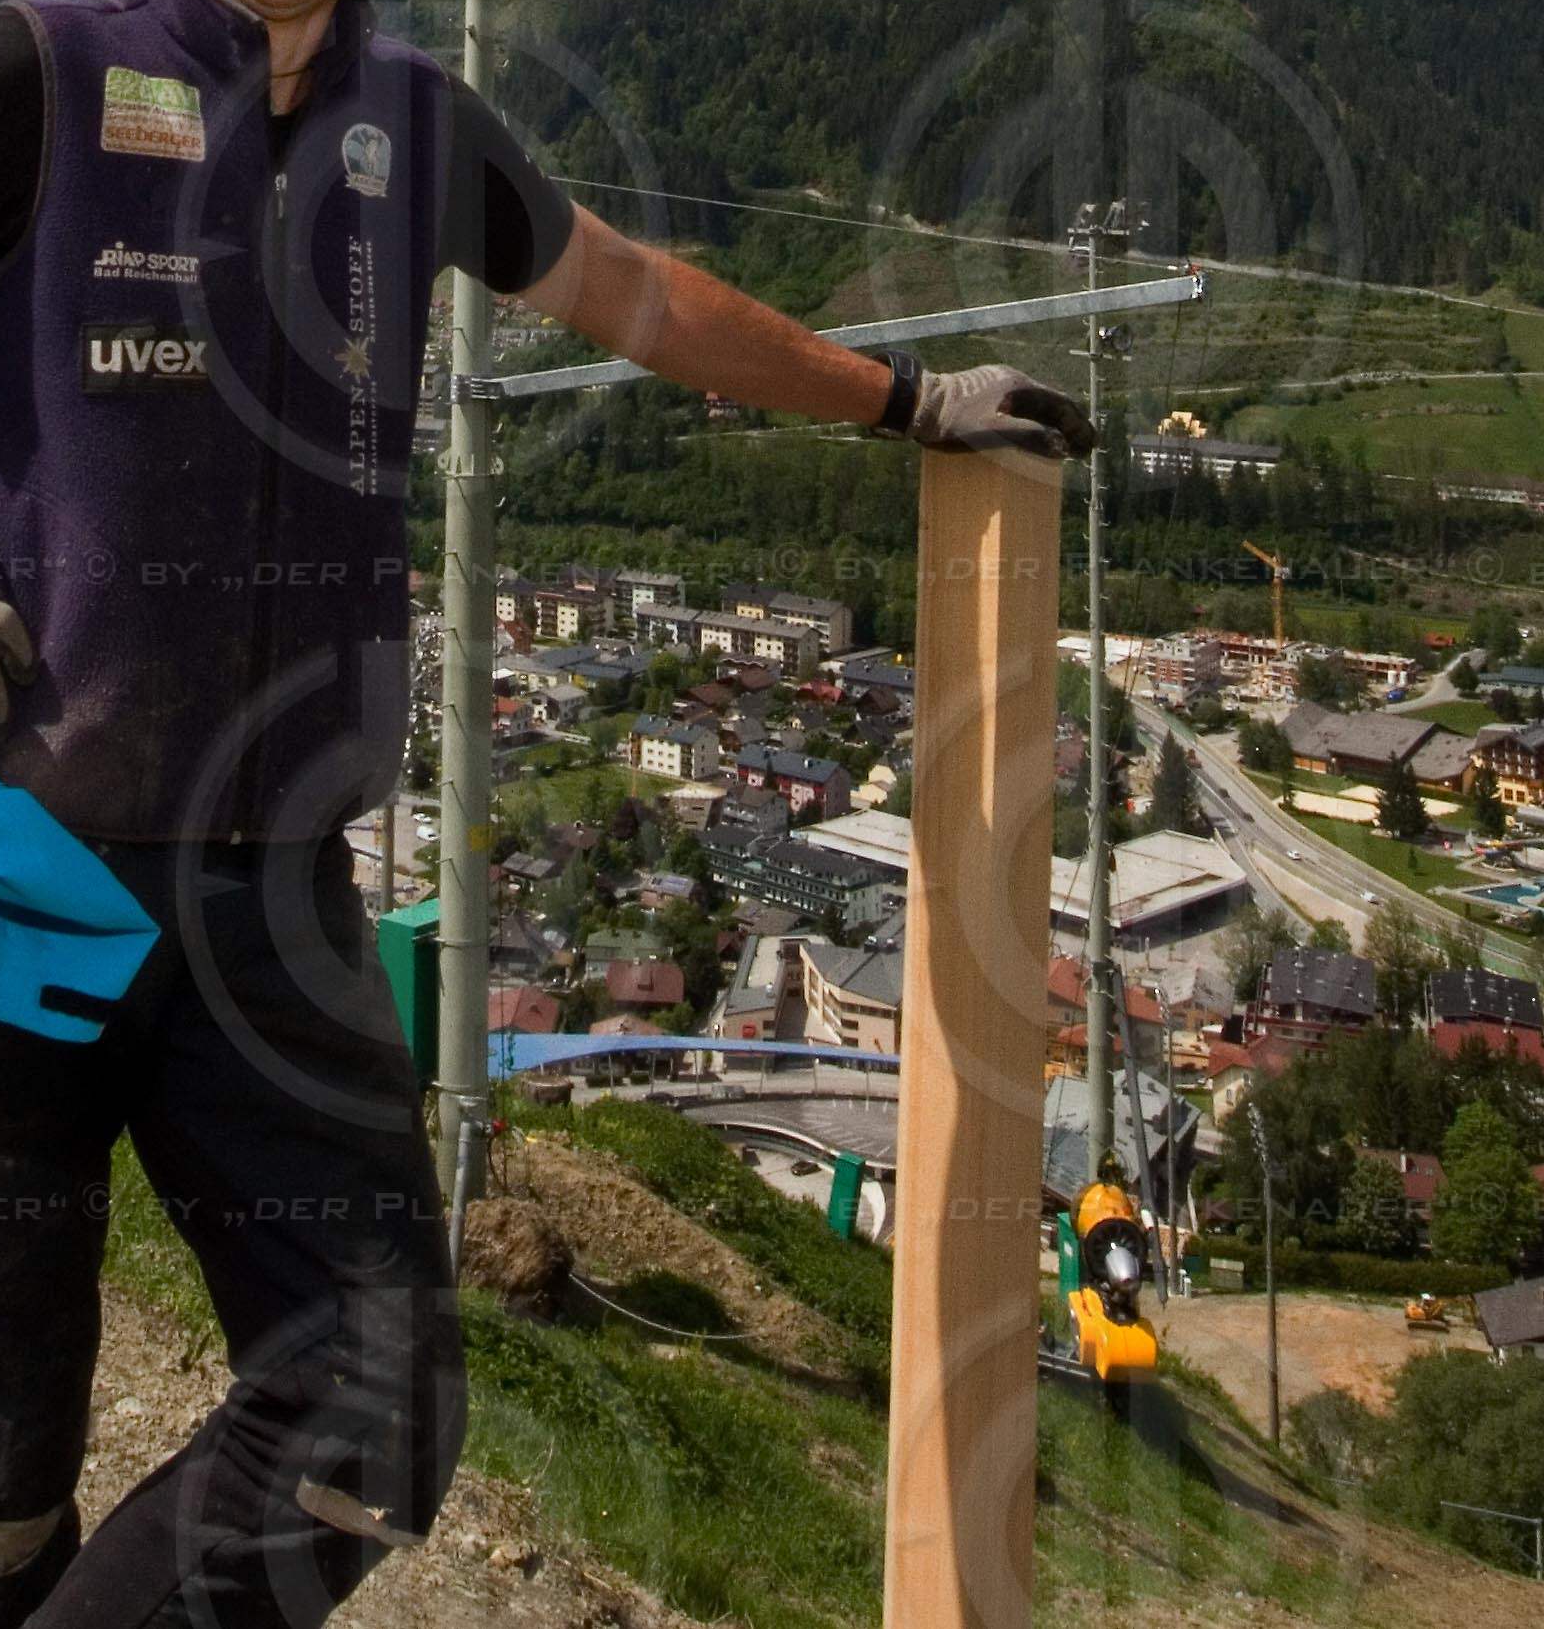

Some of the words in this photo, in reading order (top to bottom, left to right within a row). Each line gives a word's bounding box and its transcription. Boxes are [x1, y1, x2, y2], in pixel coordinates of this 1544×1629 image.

[94, 267, 120, 278] Bad
[147, 252, 199, 272] SPORT
[349, 235, 364, 332] STOFF
[91, 339, 207, 374] uvex
[350, 385, 365, 497] ALPEN
